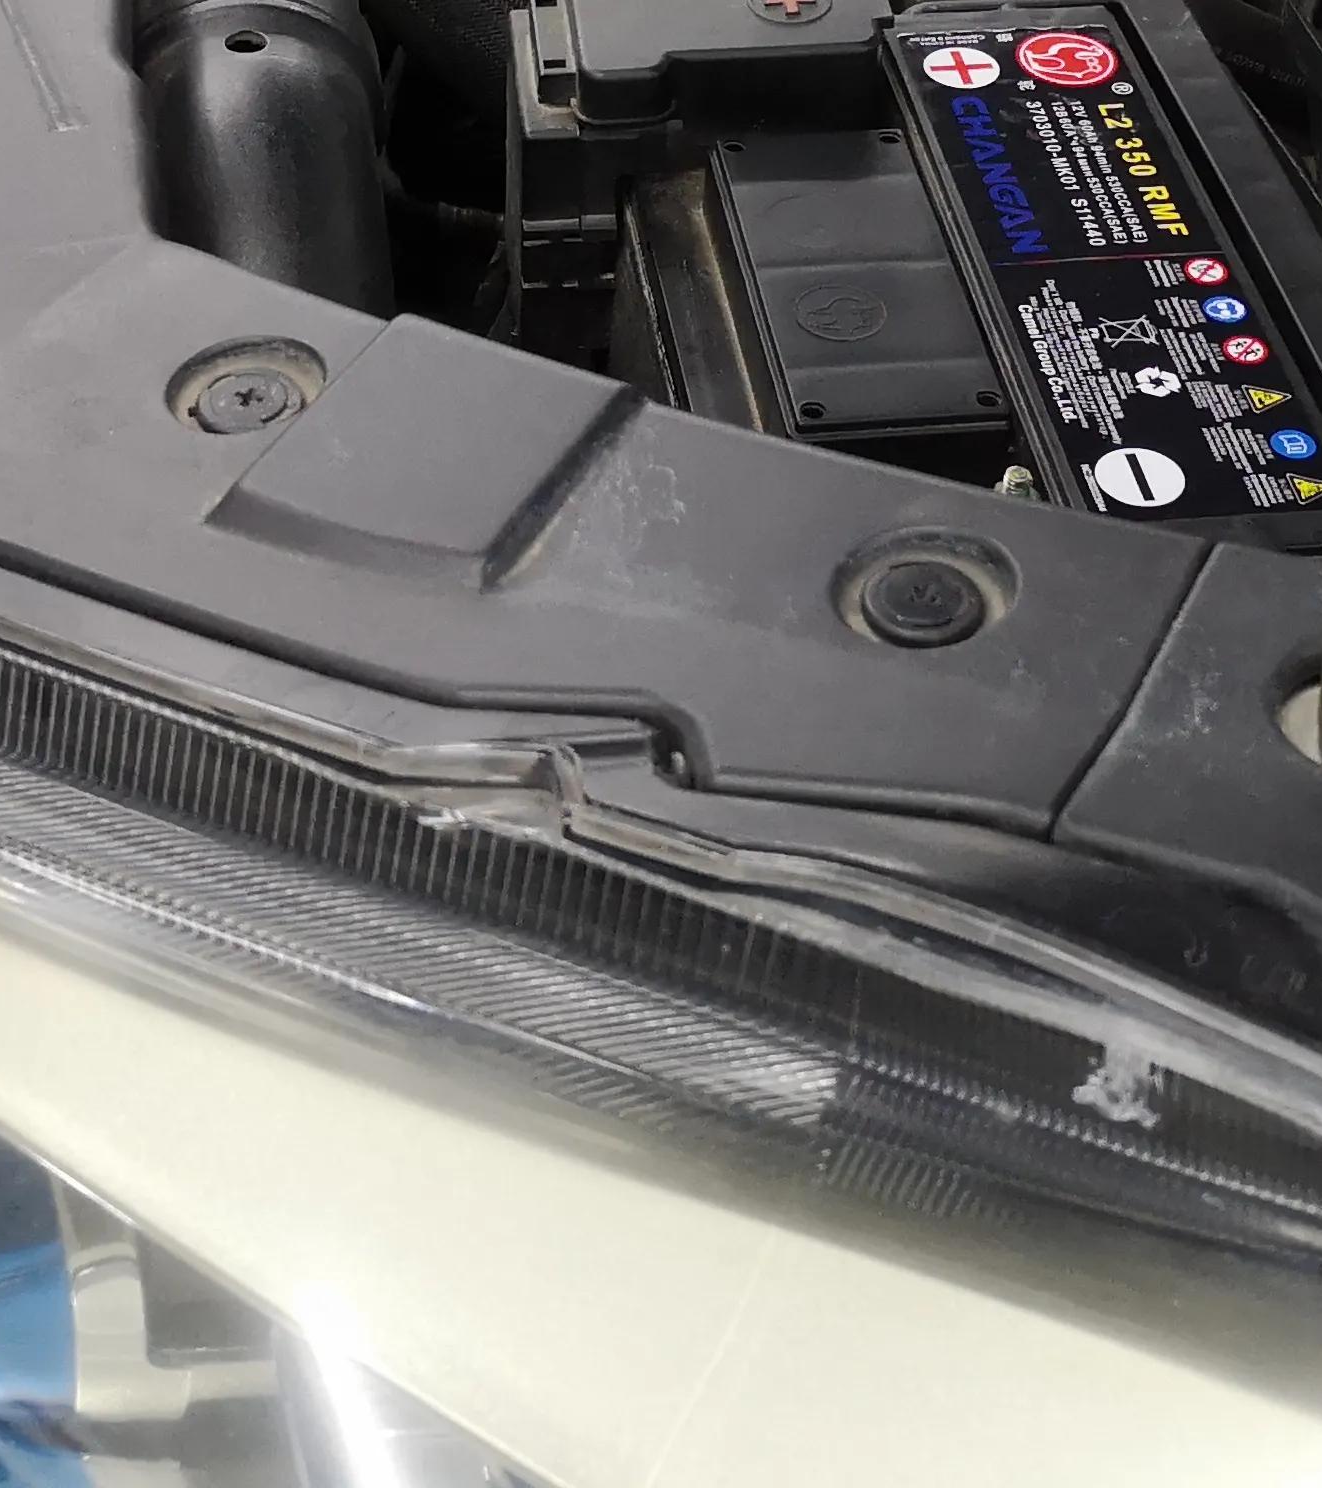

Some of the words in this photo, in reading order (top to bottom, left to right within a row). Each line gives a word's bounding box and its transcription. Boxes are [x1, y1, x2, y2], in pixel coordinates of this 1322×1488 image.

[1069, 100, 1088, 118] 12V
[1098, 103, 1133, 129] L2
[952, 96, 1050, 254] CHANGAN
[1026, 100, 1080, 191] 3703010-MK01
[1070, 198, 1107, 247] S11440
[1115, 137, 1157, 176] 350
[1138, 185, 1189, 236] RMF
[1018, 304, 1044, 339] Camel
[1032, 340, 1056, 376] Group
